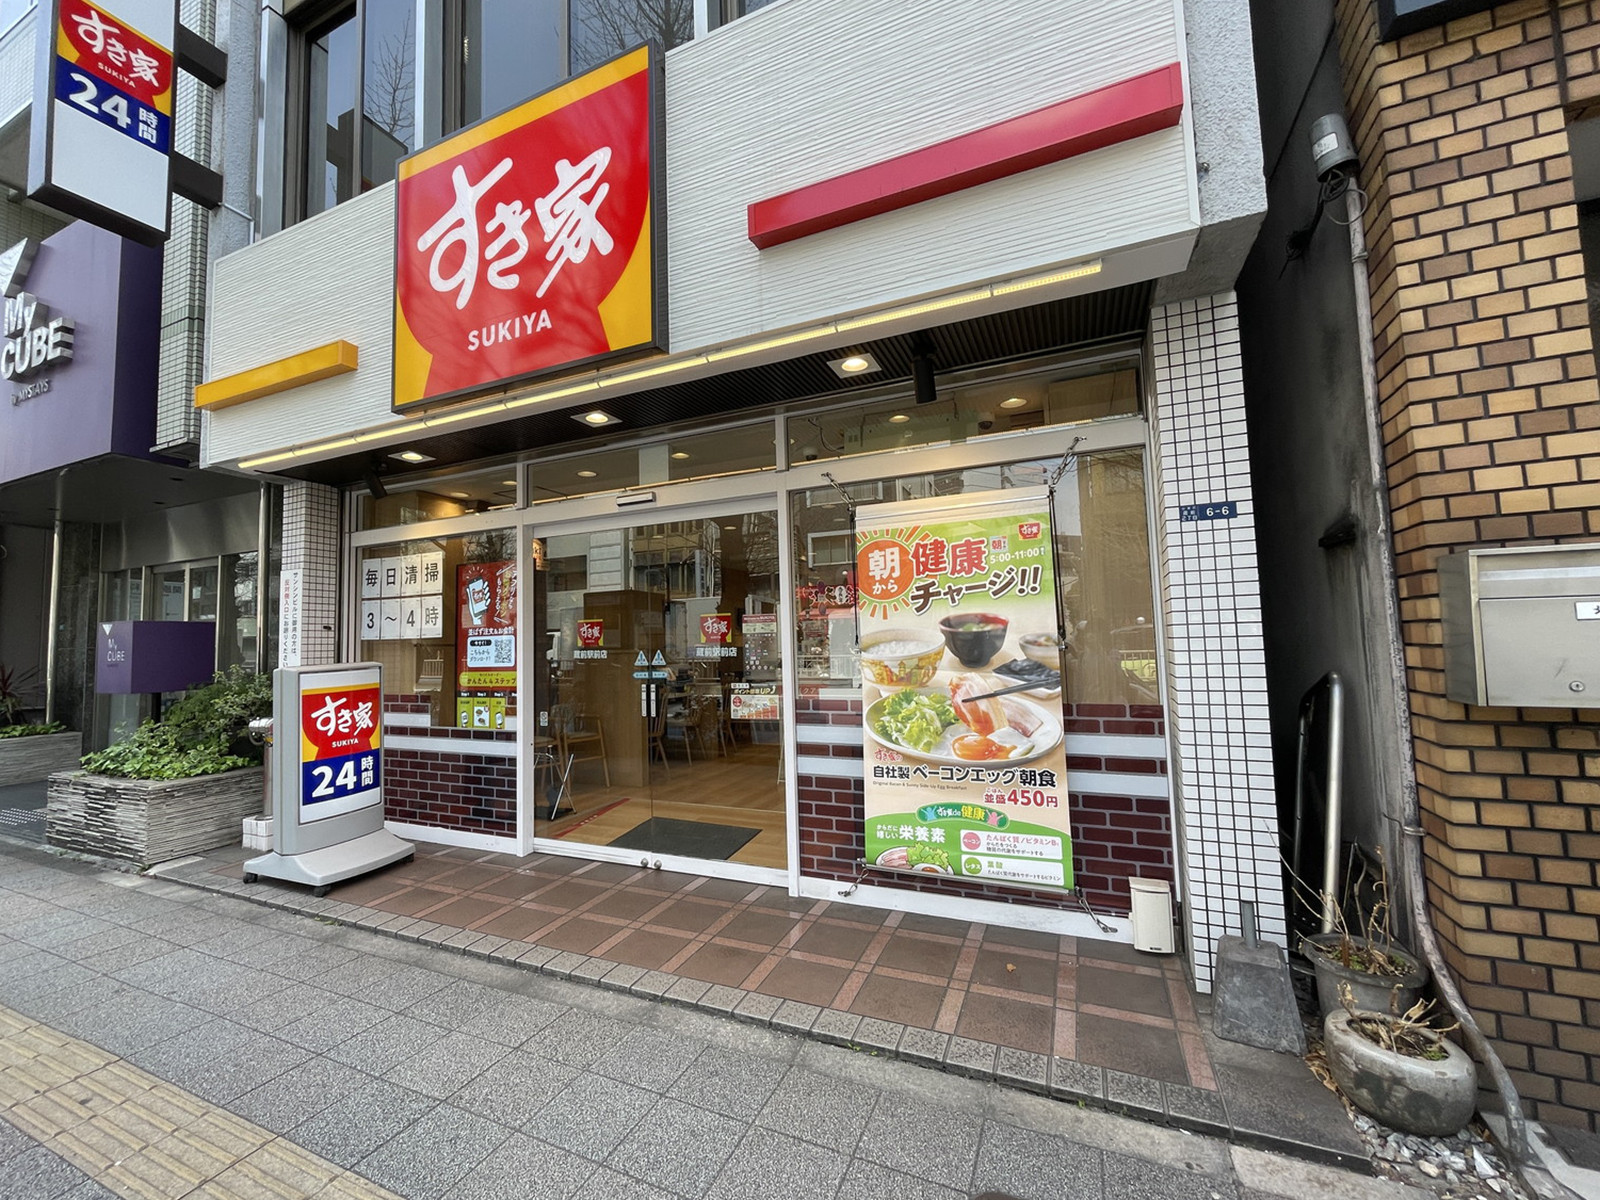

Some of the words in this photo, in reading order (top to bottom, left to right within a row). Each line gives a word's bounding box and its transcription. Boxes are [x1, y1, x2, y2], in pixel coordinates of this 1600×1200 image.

[71, 10, 159, 87] すき家
[98, 62, 136, 88] SUKIYA
[69, 73, 131, 129] 24
[139, 107, 158, 144] 時間
[417, 146, 614, 310] すき家
[467, 308, 552, 351] SUKIYA
[1, 317, 68, 380] CUBE
[1206, 506, 1230, 517] 6-6
[868, 547, 900, 580] 朝
[911, 537, 988, 578] 健康
[990, 547, 1040, 564] 5:00-11:00
[366, 562, 439, 588] 毎日清掃
[872, 580, 898, 595] から
[910, 566, 1041, 613] チャージ!!
[580, 623, 601, 640] すき家
[703, 617, 728, 635] すき家
[107, 651, 125, 661] CUBE
[311, 695, 373, 737] すき家
[331, 738, 359, 748] SUKIYA
[311, 760, 357, 798] 24
[361, 755, 374, 787] 時間
[873, 765, 910, 779] 自社製
[913, 765, 1056, 788] ベーコンエッグ朝食
[899, 824, 946, 843] 栄養素
